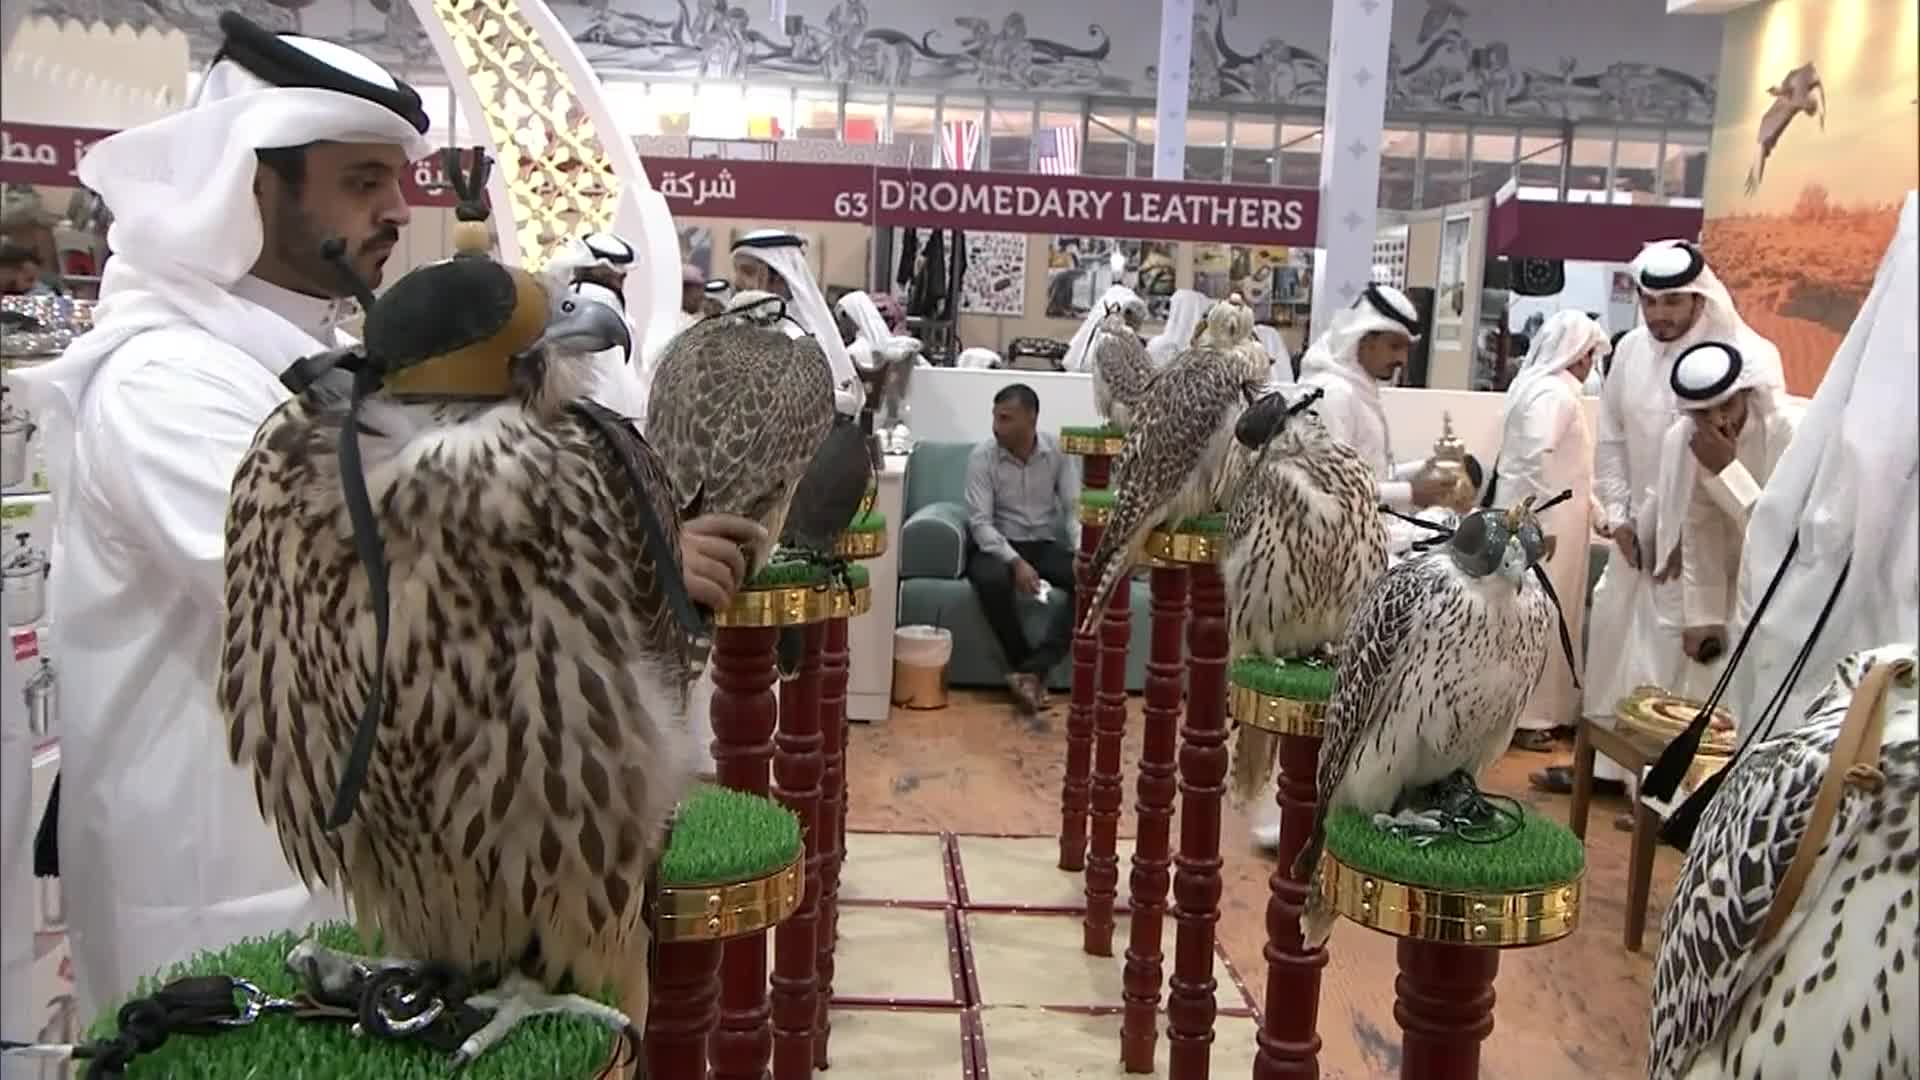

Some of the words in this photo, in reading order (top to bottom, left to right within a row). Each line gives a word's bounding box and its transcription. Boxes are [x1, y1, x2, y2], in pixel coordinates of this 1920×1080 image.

[660, 168, 736, 205] شركة
[834, 193, 868, 217] 63
[1122, 191, 1303, 230] LEATHERS
